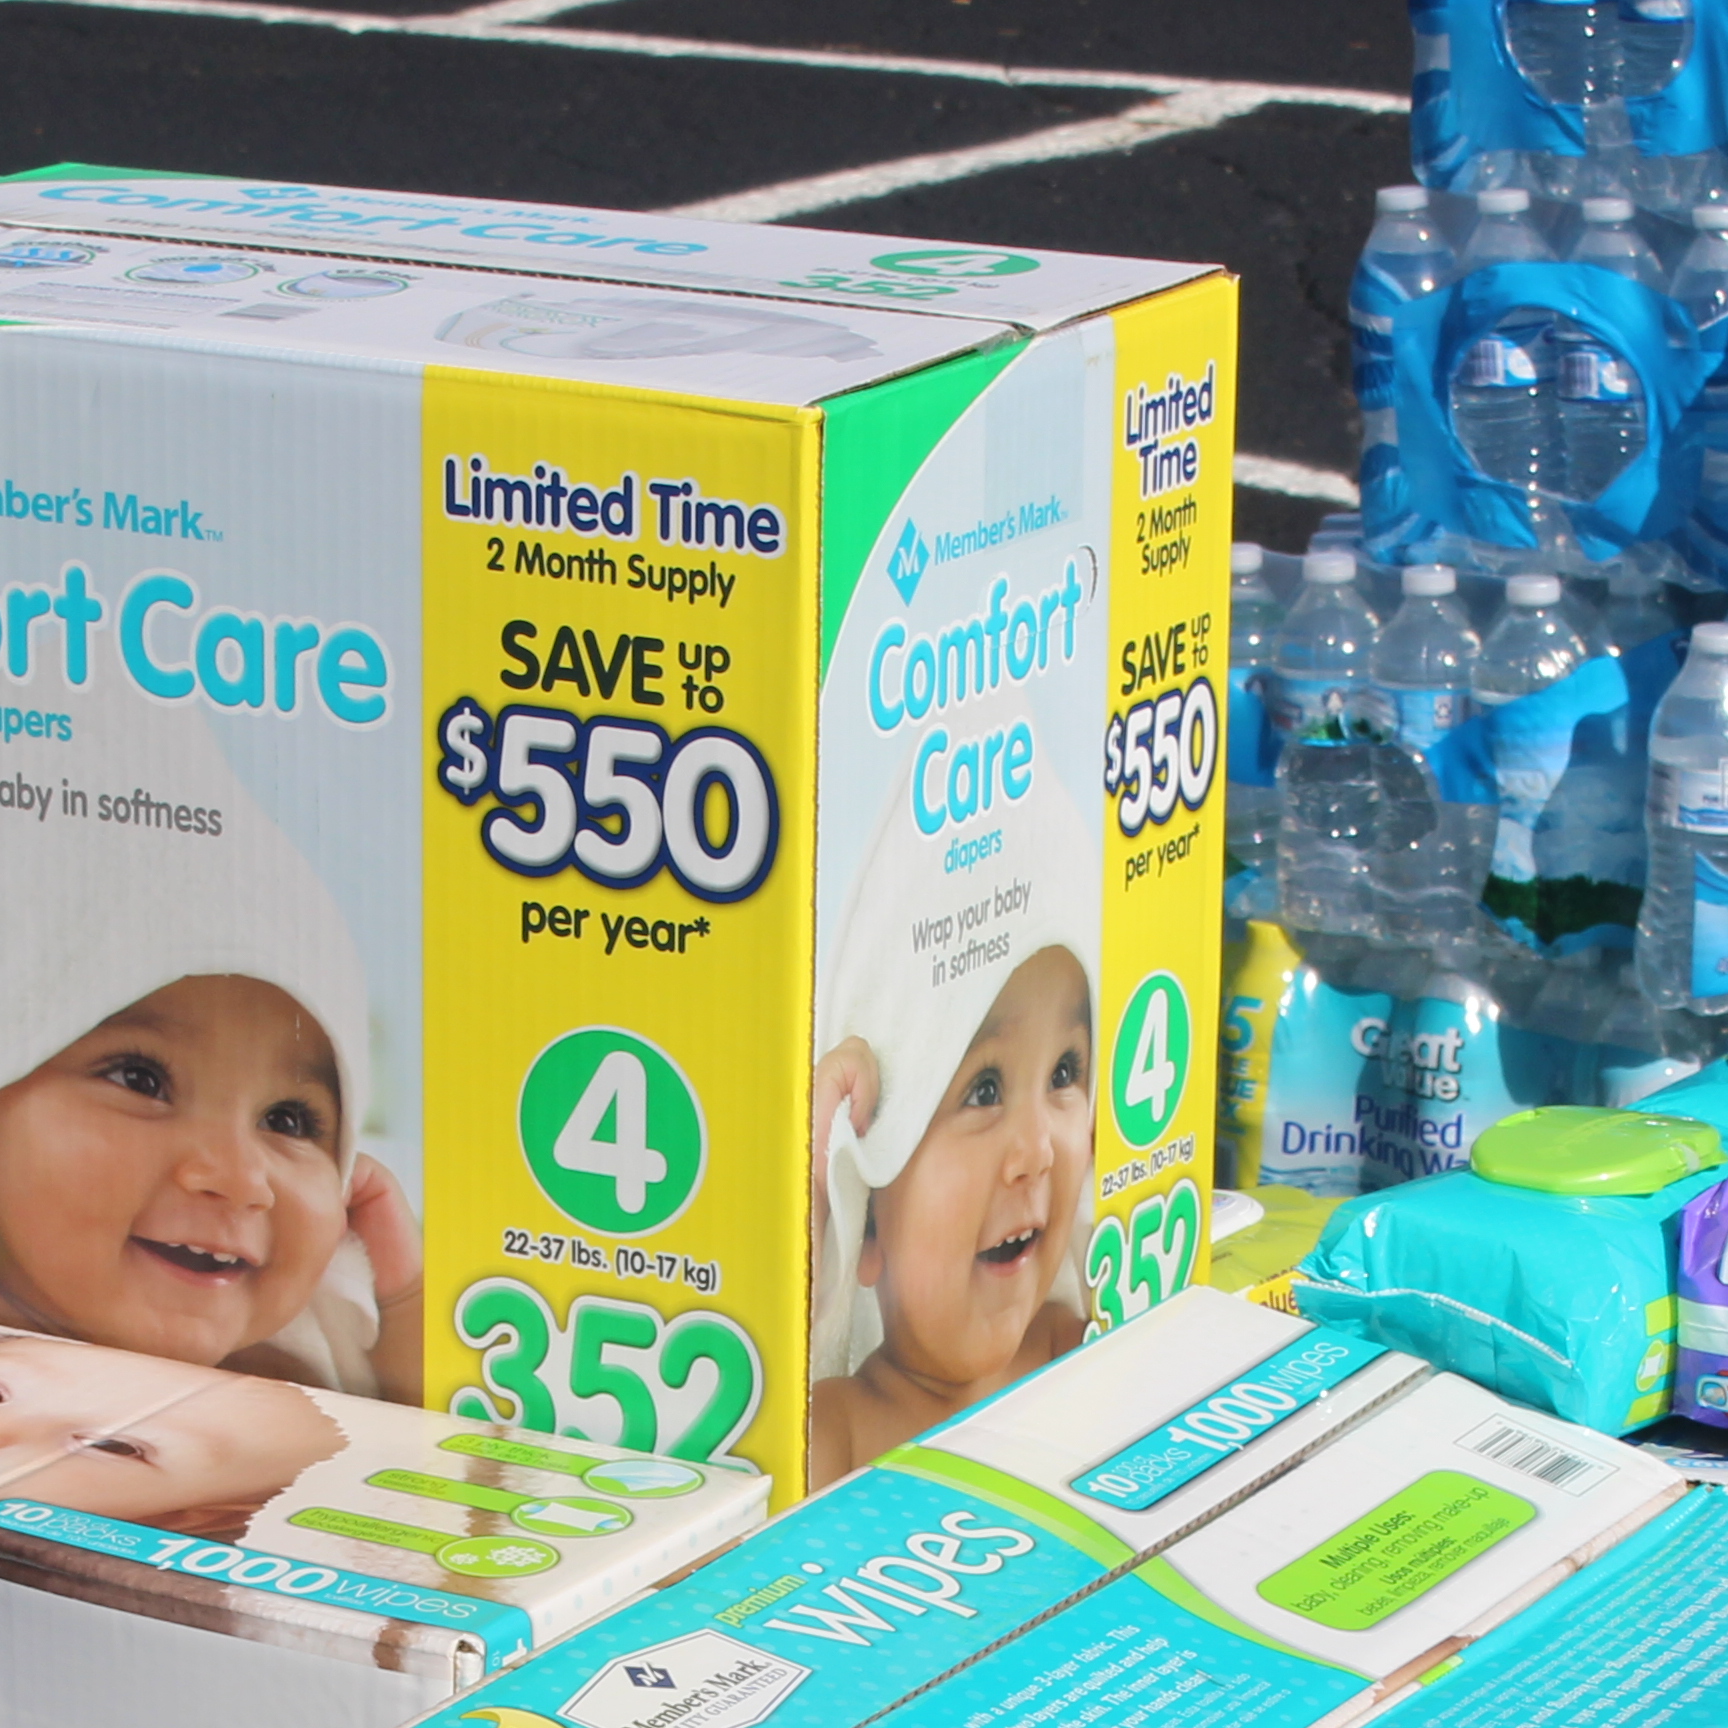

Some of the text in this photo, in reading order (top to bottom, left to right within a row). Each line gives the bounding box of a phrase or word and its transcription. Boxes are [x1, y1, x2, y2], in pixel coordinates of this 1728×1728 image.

[39, 185, 462, 231] Comfort
[460, 223, 709, 256] Care
[1125, 363, 1214, 446] Limited
[443, 455, 781, 554] Limited Time
[1139, 440, 1197, 498] Time
[486, 538, 735, 607] 2 Month Supply
[1141, 533, 1191, 577] Supply
[119, 574, 391, 725] Care
[499, 619, 731, 706] SAVE up
[870, 560, 1082, 730] Comfort
[1122, 612, 1211, 696] SAVE up
[912, 721, 1034, 837] Care
[1104, 677, 1216, 837] $550
[62, 783, 88, 818] in
[97, 789, 222, 837] softness
[438, 697, 777, 904] $550
[944, 828, 1003, 875] diapers
[521, 902, 590, 946] per
[1124, 987, 1176, 1123] 4
[1350, 1019, 1465, 1074] Great
[552, 1050, 668, 1215] 4
[1281, 1120, 1413, 1178] Drinking
[1354, 1095, 1464, 1149] Purified
[451, 1281, 761, 1453] 352
[44, 1514, 143, 1551] packs
[152, 1536, 340, 1595] 1,000
[336, 1570, 478, 1620] wipes
[714, 1510, 1036, 1648] premium wipes
